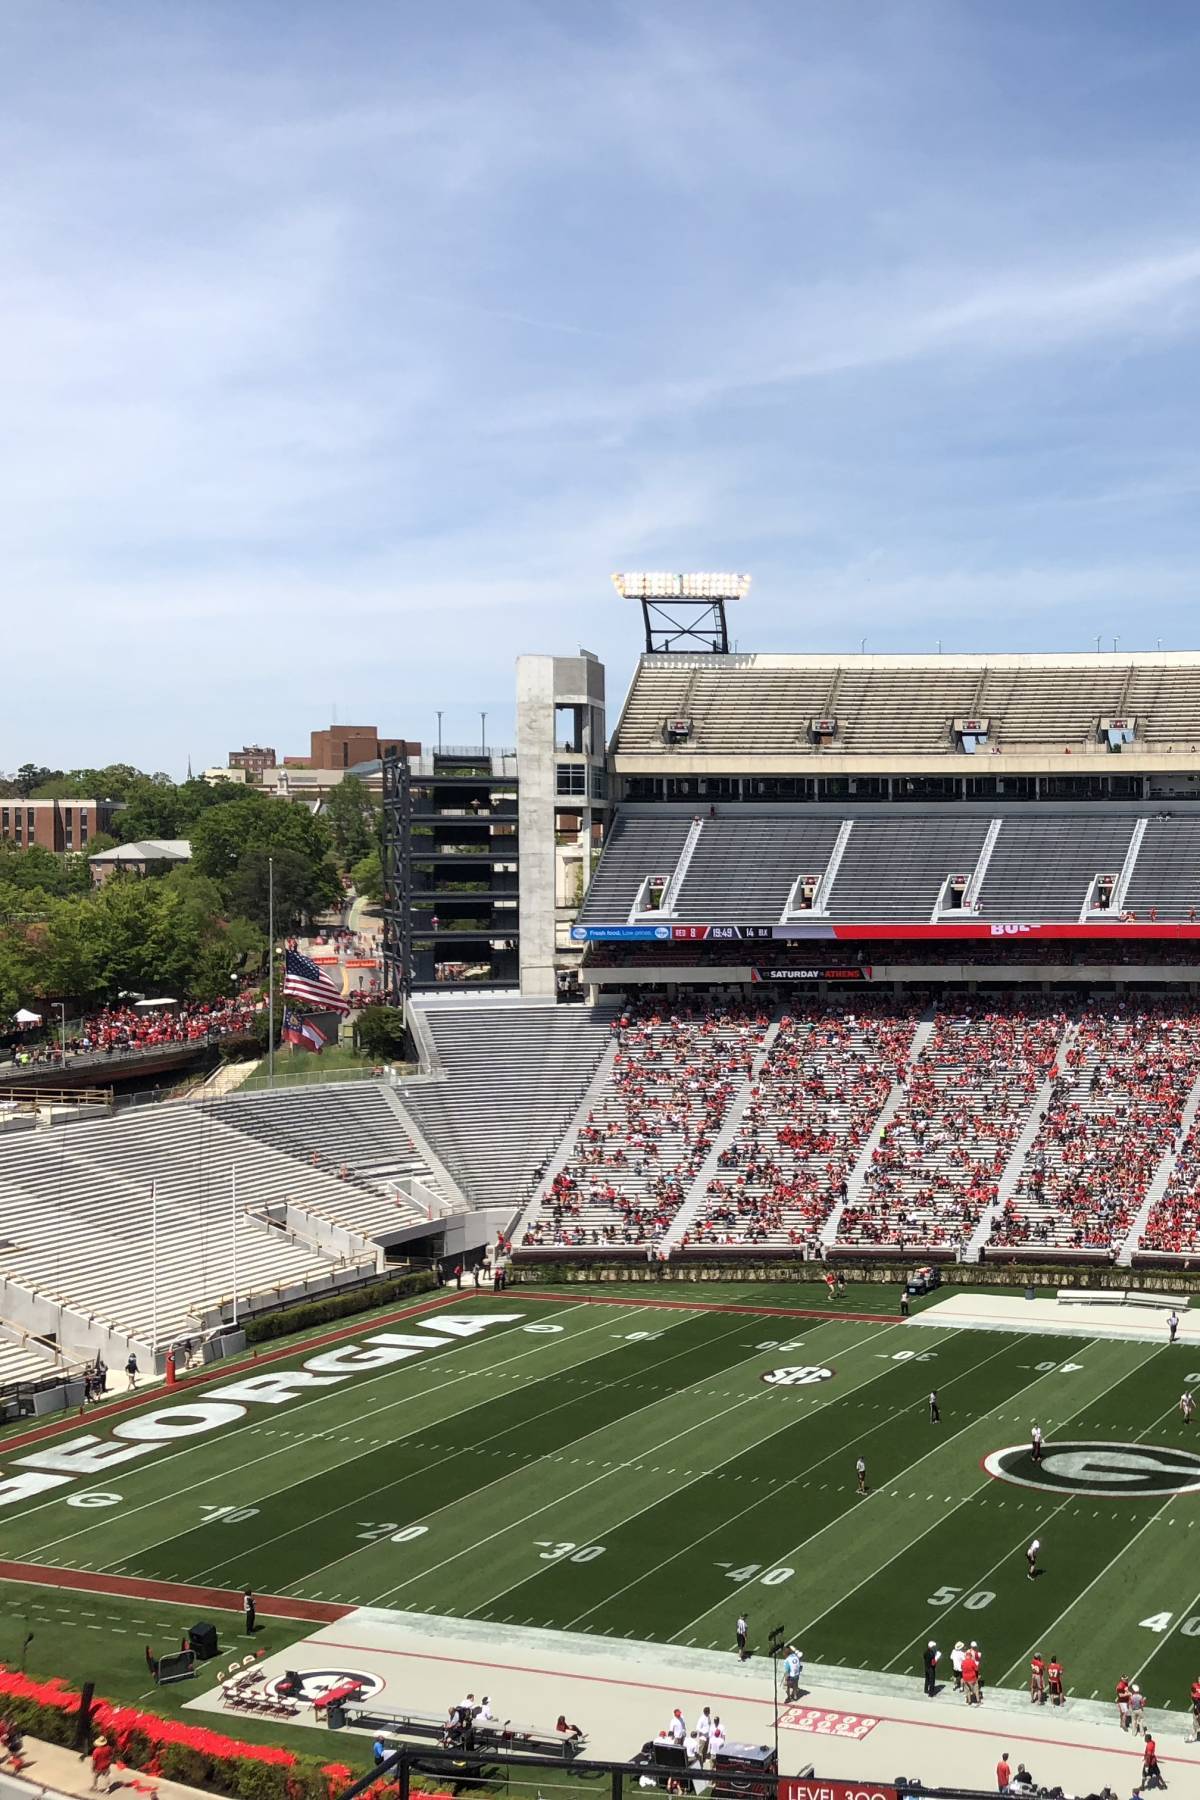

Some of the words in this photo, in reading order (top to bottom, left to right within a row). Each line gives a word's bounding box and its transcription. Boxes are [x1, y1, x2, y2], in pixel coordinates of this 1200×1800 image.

[713, 928, 733, 938] 19:49
[746, 927, 754, 937] 14
[770, 970, 819, 978] SATURDAY
[756, 1341, 804, 1352] 20
[892, 1351, 938, 1362] 30
[1035, 1361, 1084, 1373] 40
[762, 1365, 834, 1385] SEC
[201, 1506, 260, 1523] 10
[362, 1523, 429, 1542] 20
[539, 1542, 607, 1562] 30
[725, 1564, 796, 1585] 40
[926, 1586, 997, 1610] 50
[788, 1785, 834, 1800] LEVEL
